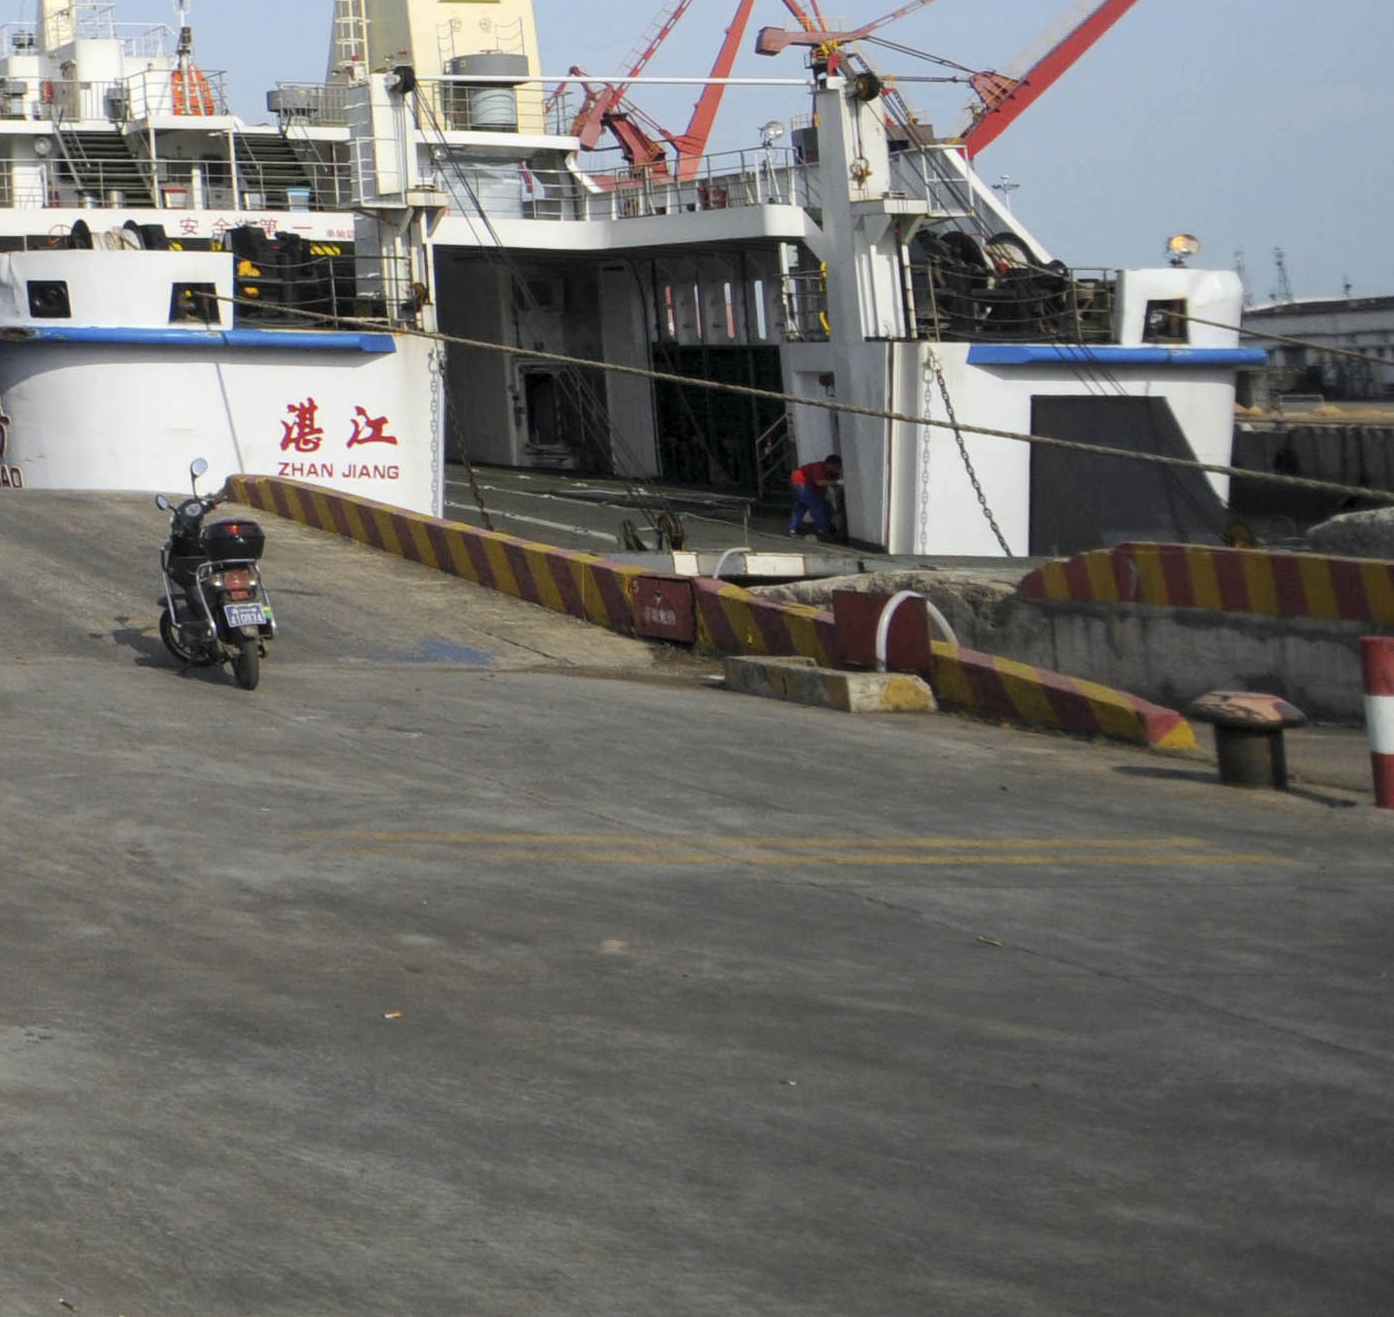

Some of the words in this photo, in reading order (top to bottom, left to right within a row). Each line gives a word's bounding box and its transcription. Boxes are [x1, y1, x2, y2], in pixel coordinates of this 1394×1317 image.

[280, 397, 398, 452] 湛江
[278, 462, 334, 478] ZHAN
[342, 464, 400, 480] JIANG
